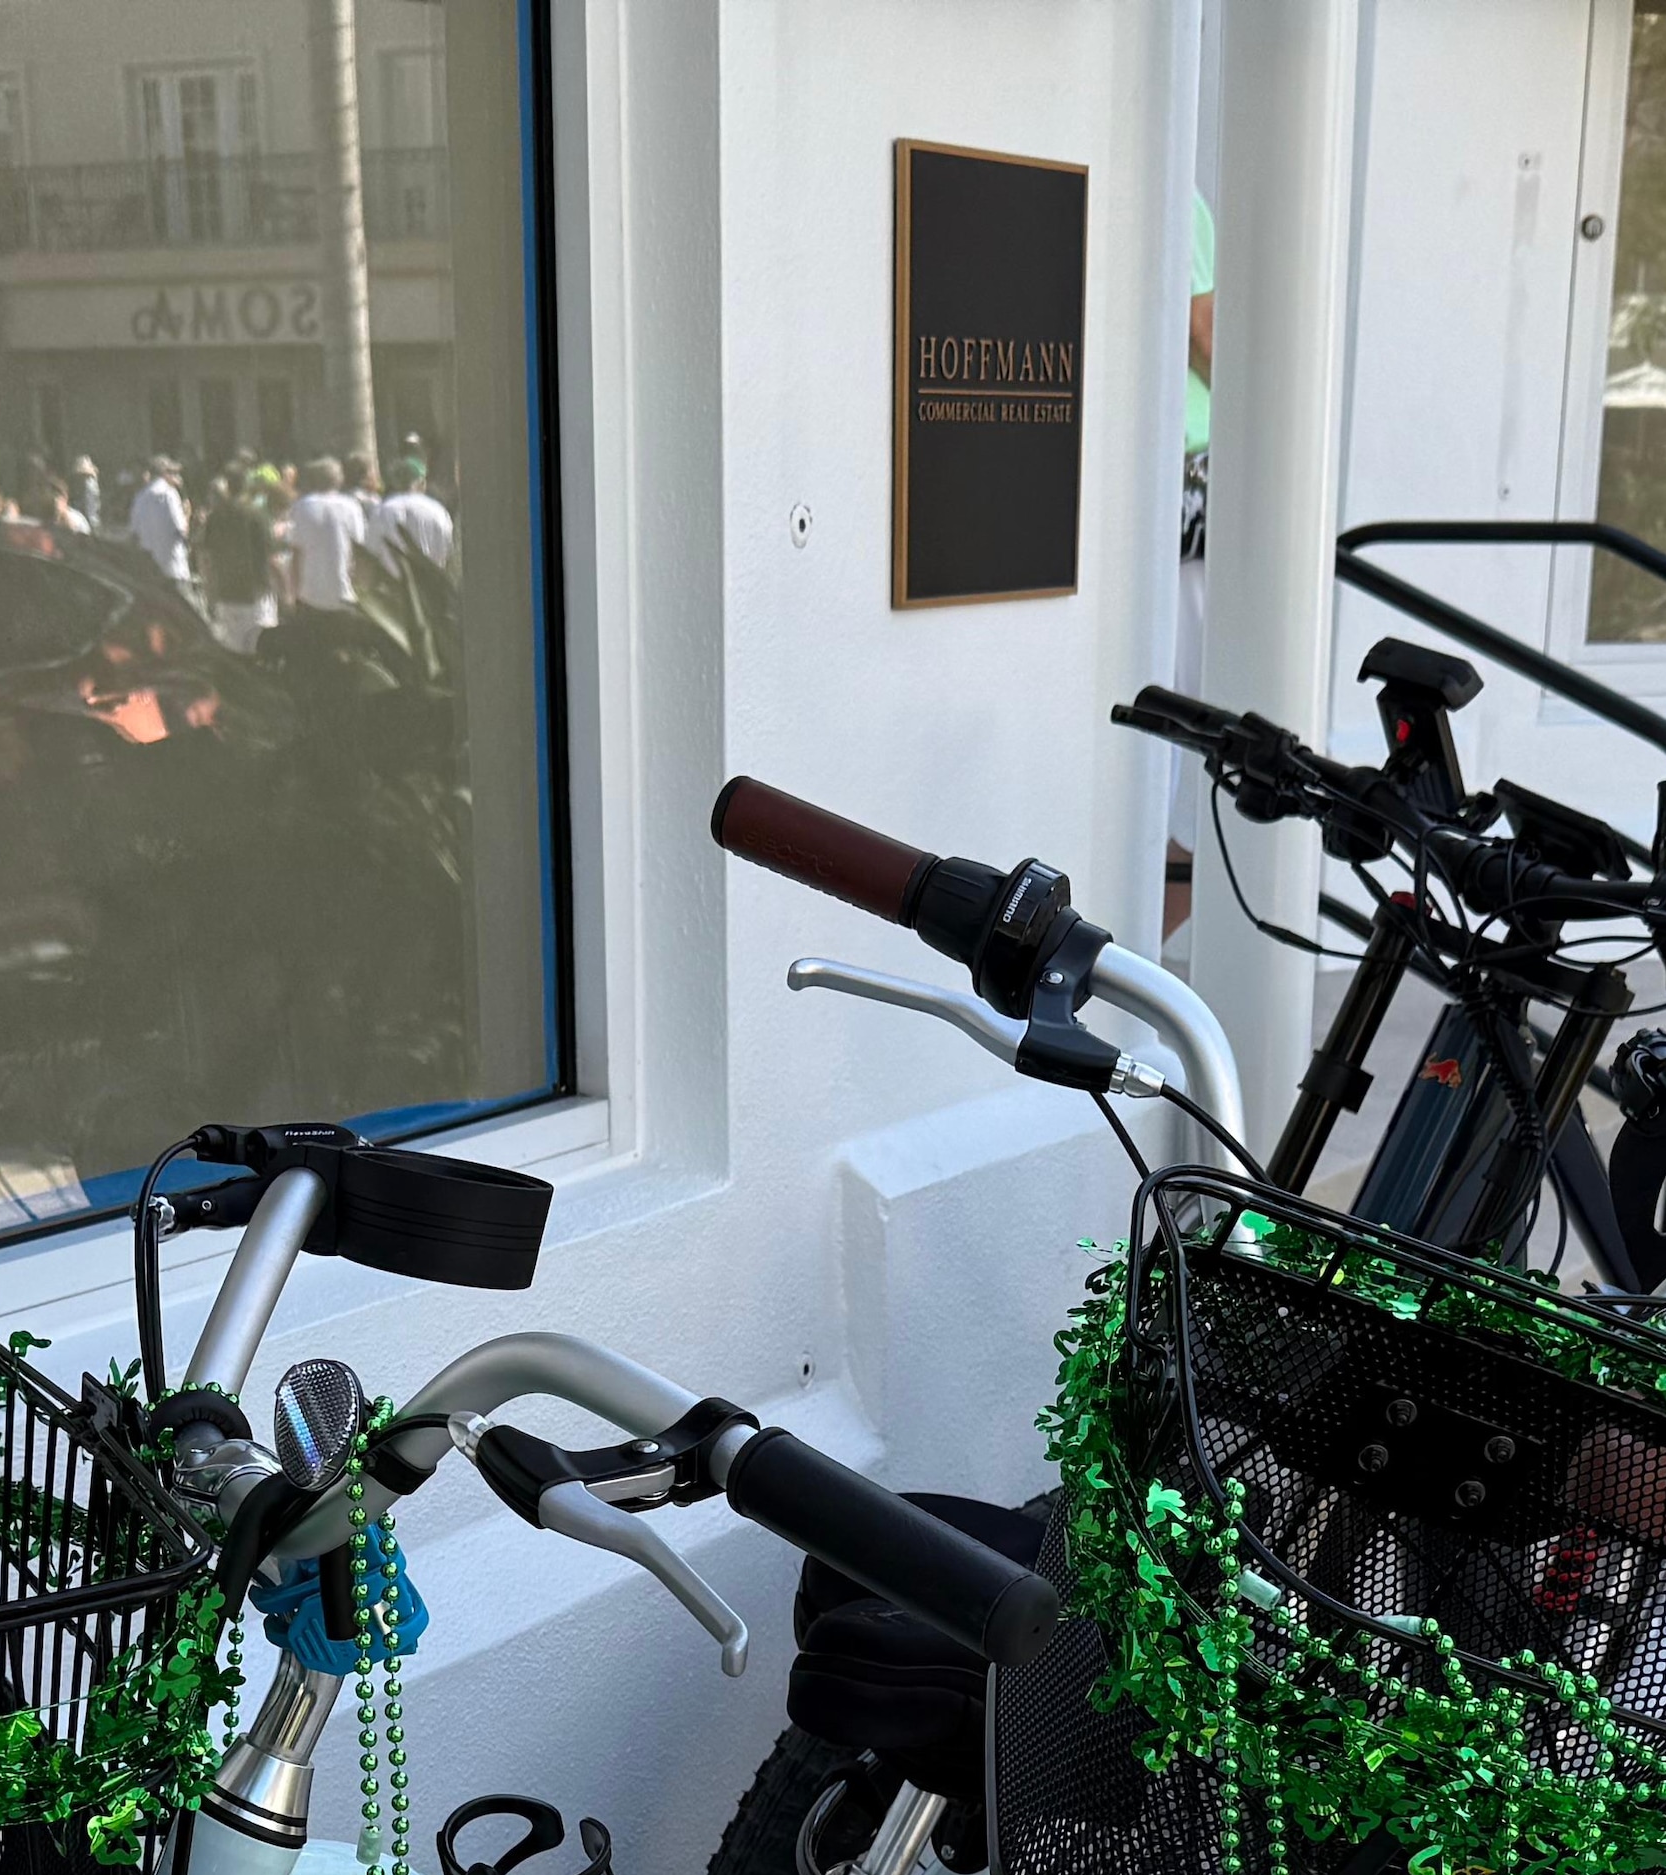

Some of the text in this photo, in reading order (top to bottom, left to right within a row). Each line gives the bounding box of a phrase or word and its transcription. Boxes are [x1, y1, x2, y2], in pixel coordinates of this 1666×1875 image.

[919, 336, 1074, 383] HOFFMANN
[917, 402, 1073, 423] COMMERCIAL REAL ESTATE
